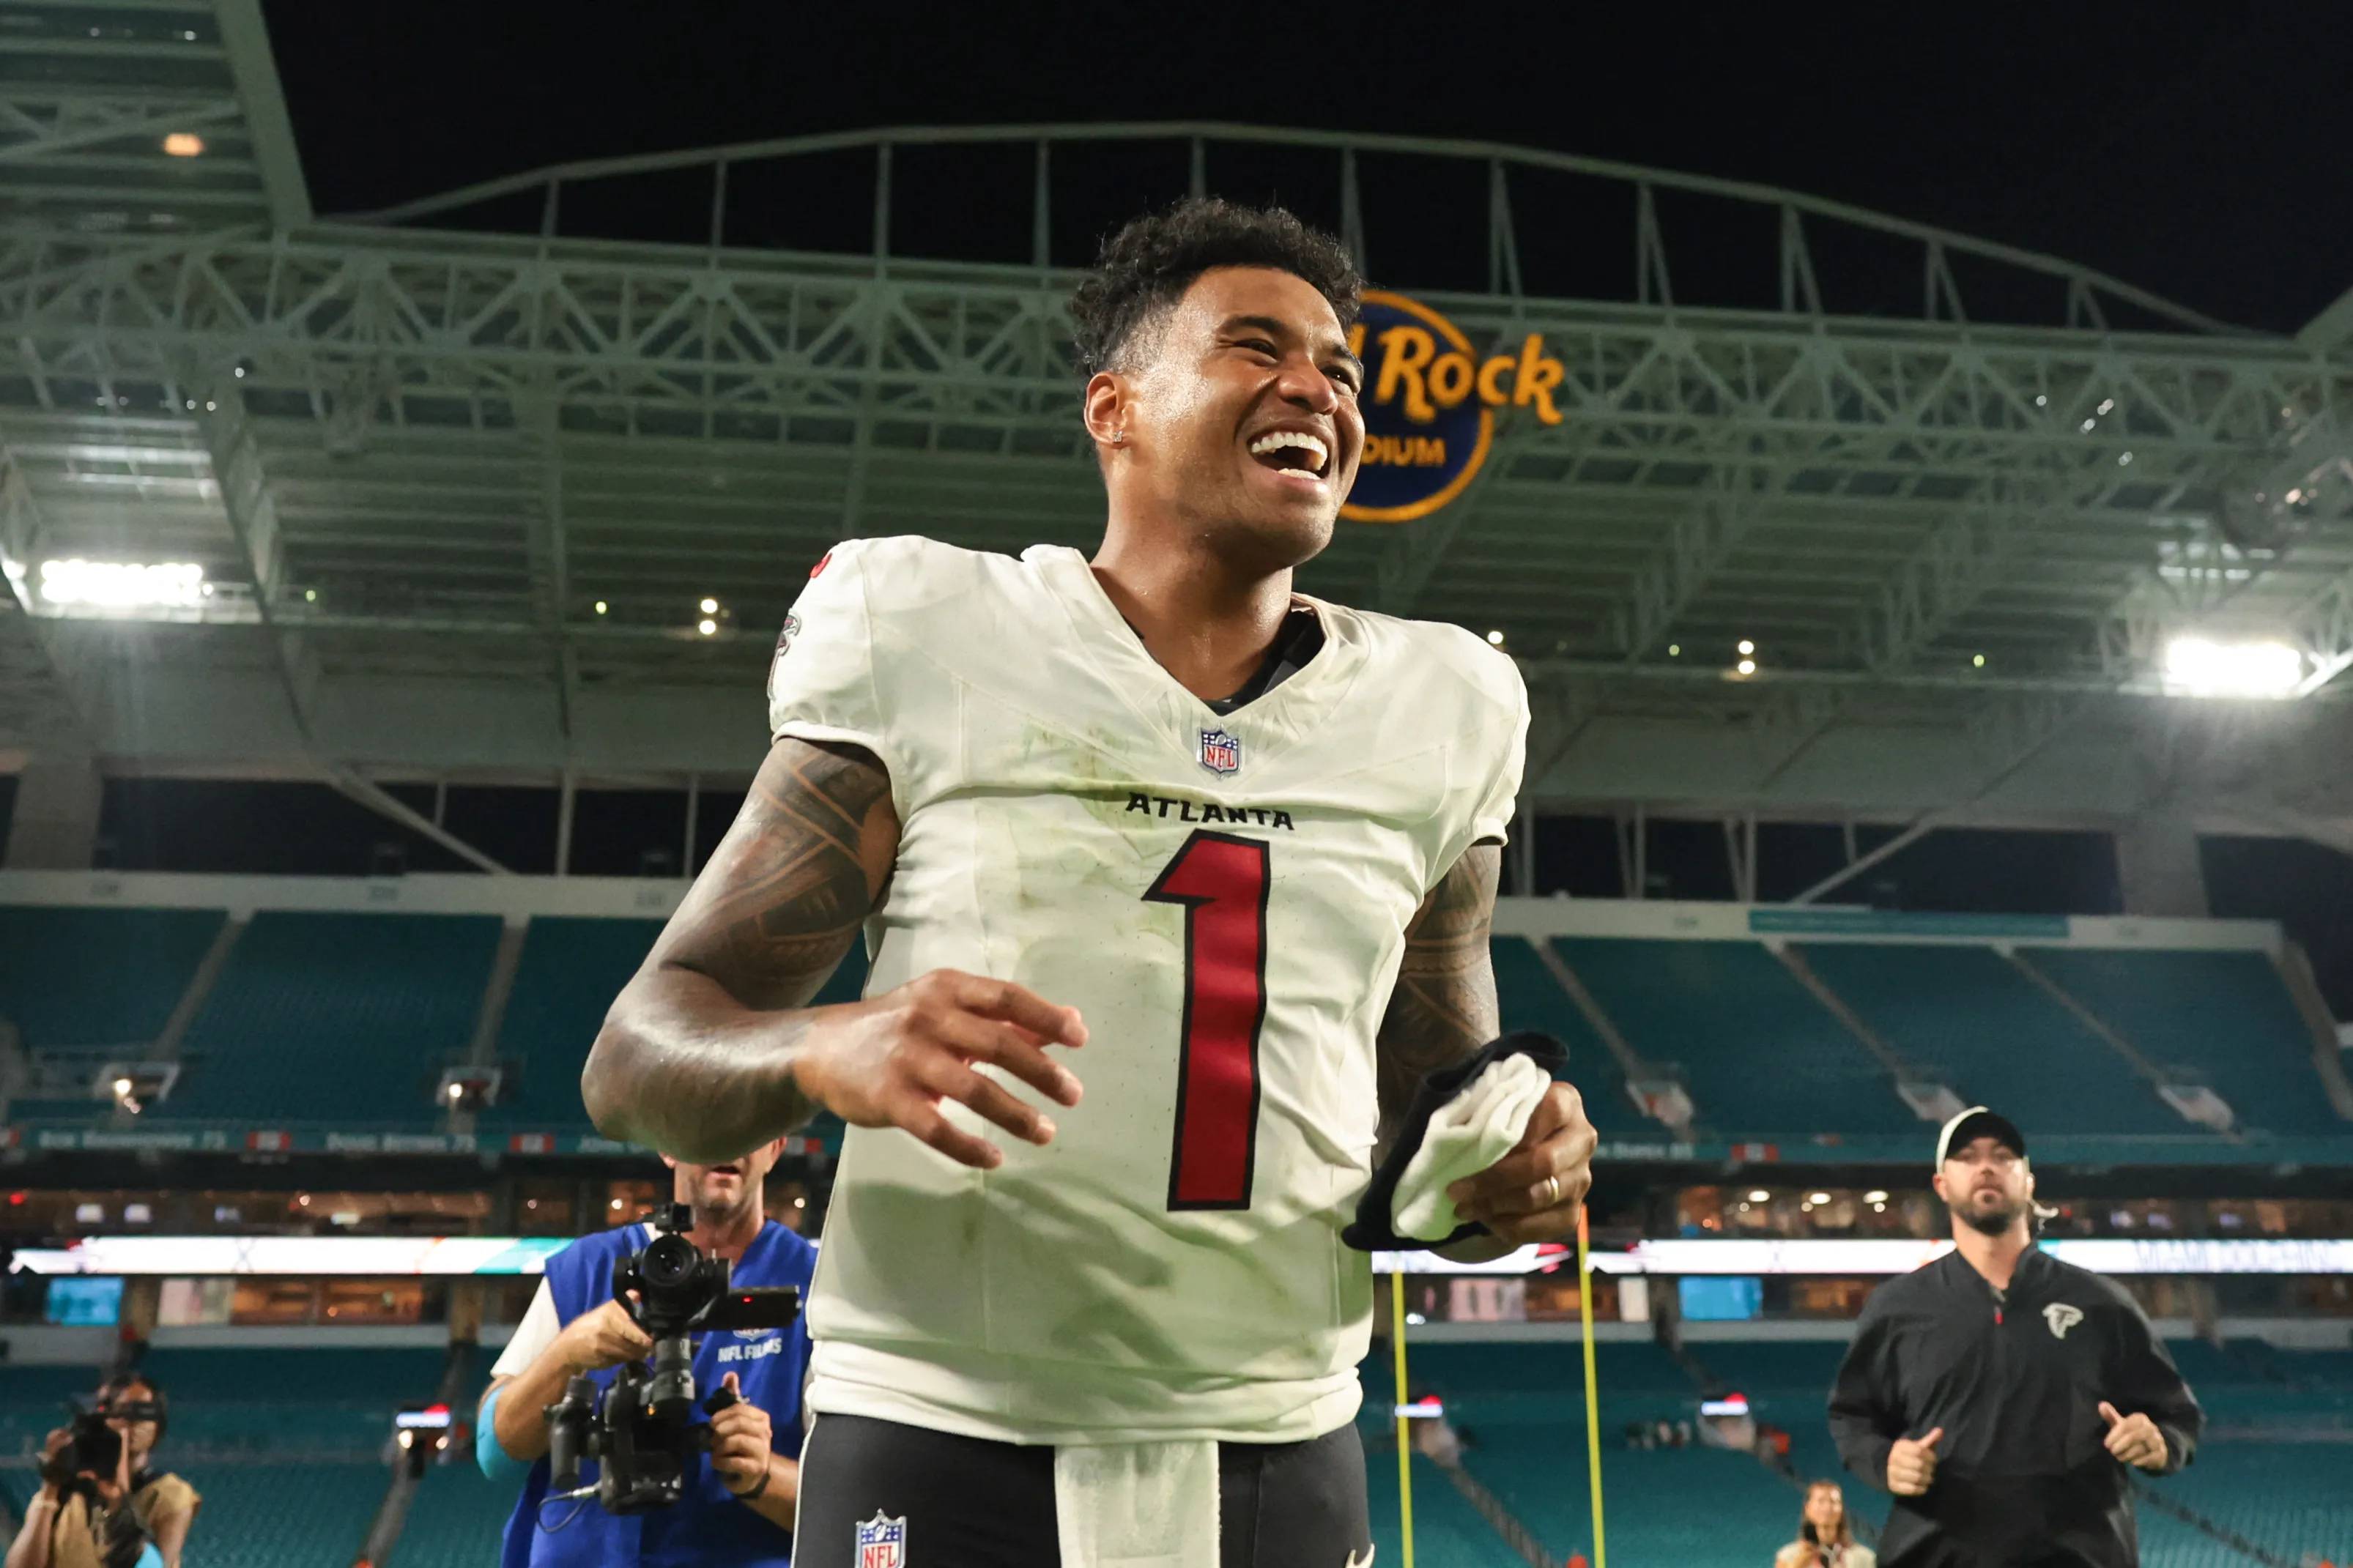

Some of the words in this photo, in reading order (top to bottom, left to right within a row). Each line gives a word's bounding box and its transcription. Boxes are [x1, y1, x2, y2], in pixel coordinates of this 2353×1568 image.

[1374, 325, 1565, 425] Rock
[1360, 434, 1446, 466] DIUM
[1206, 746, 1236, 768] NFL
[1125, 791, 1294, 831] ATLANTA
[1141, 827, 1271, 1212] 1
[717, 1345, 744, 1362] NFL
[864, 1545, 897, 1568] NFL
